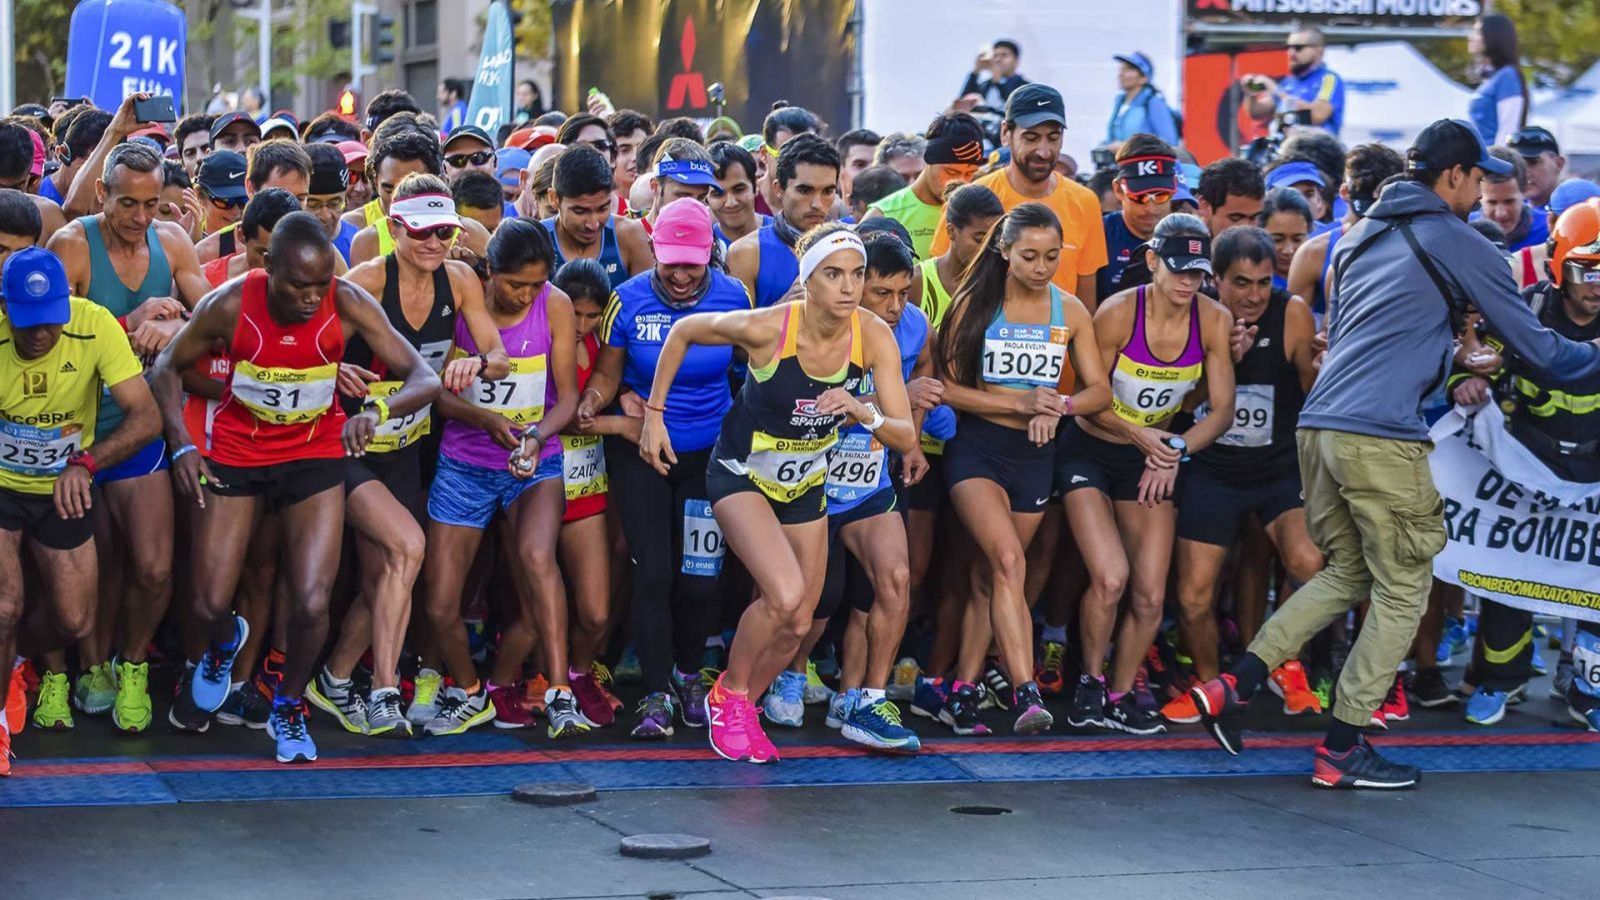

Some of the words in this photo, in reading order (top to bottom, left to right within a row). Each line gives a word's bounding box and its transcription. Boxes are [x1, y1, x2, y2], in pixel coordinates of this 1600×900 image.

[1376, 0, 1481, 16] MOTORS
[108, 30, 178, 76] 21K
[636, 323, 662, 341] 21K
[1004, 341, 1024, 349] PAOLA
[984, 350, 1062, 379] 13025
[262, 388, 300, 409] 31
[479, 380, 517, 405] 37
[1136, 387, 1174, 409] 66
[789, 415, 835, 426] SPARTA
[1235, 408, 1268, 428] 99
[0, 442, 75, 466] 2534
[776, 460, 813, 483] 69
[830, 461, 877, 484] 496
[1475, 468, 1524, 510] DE
